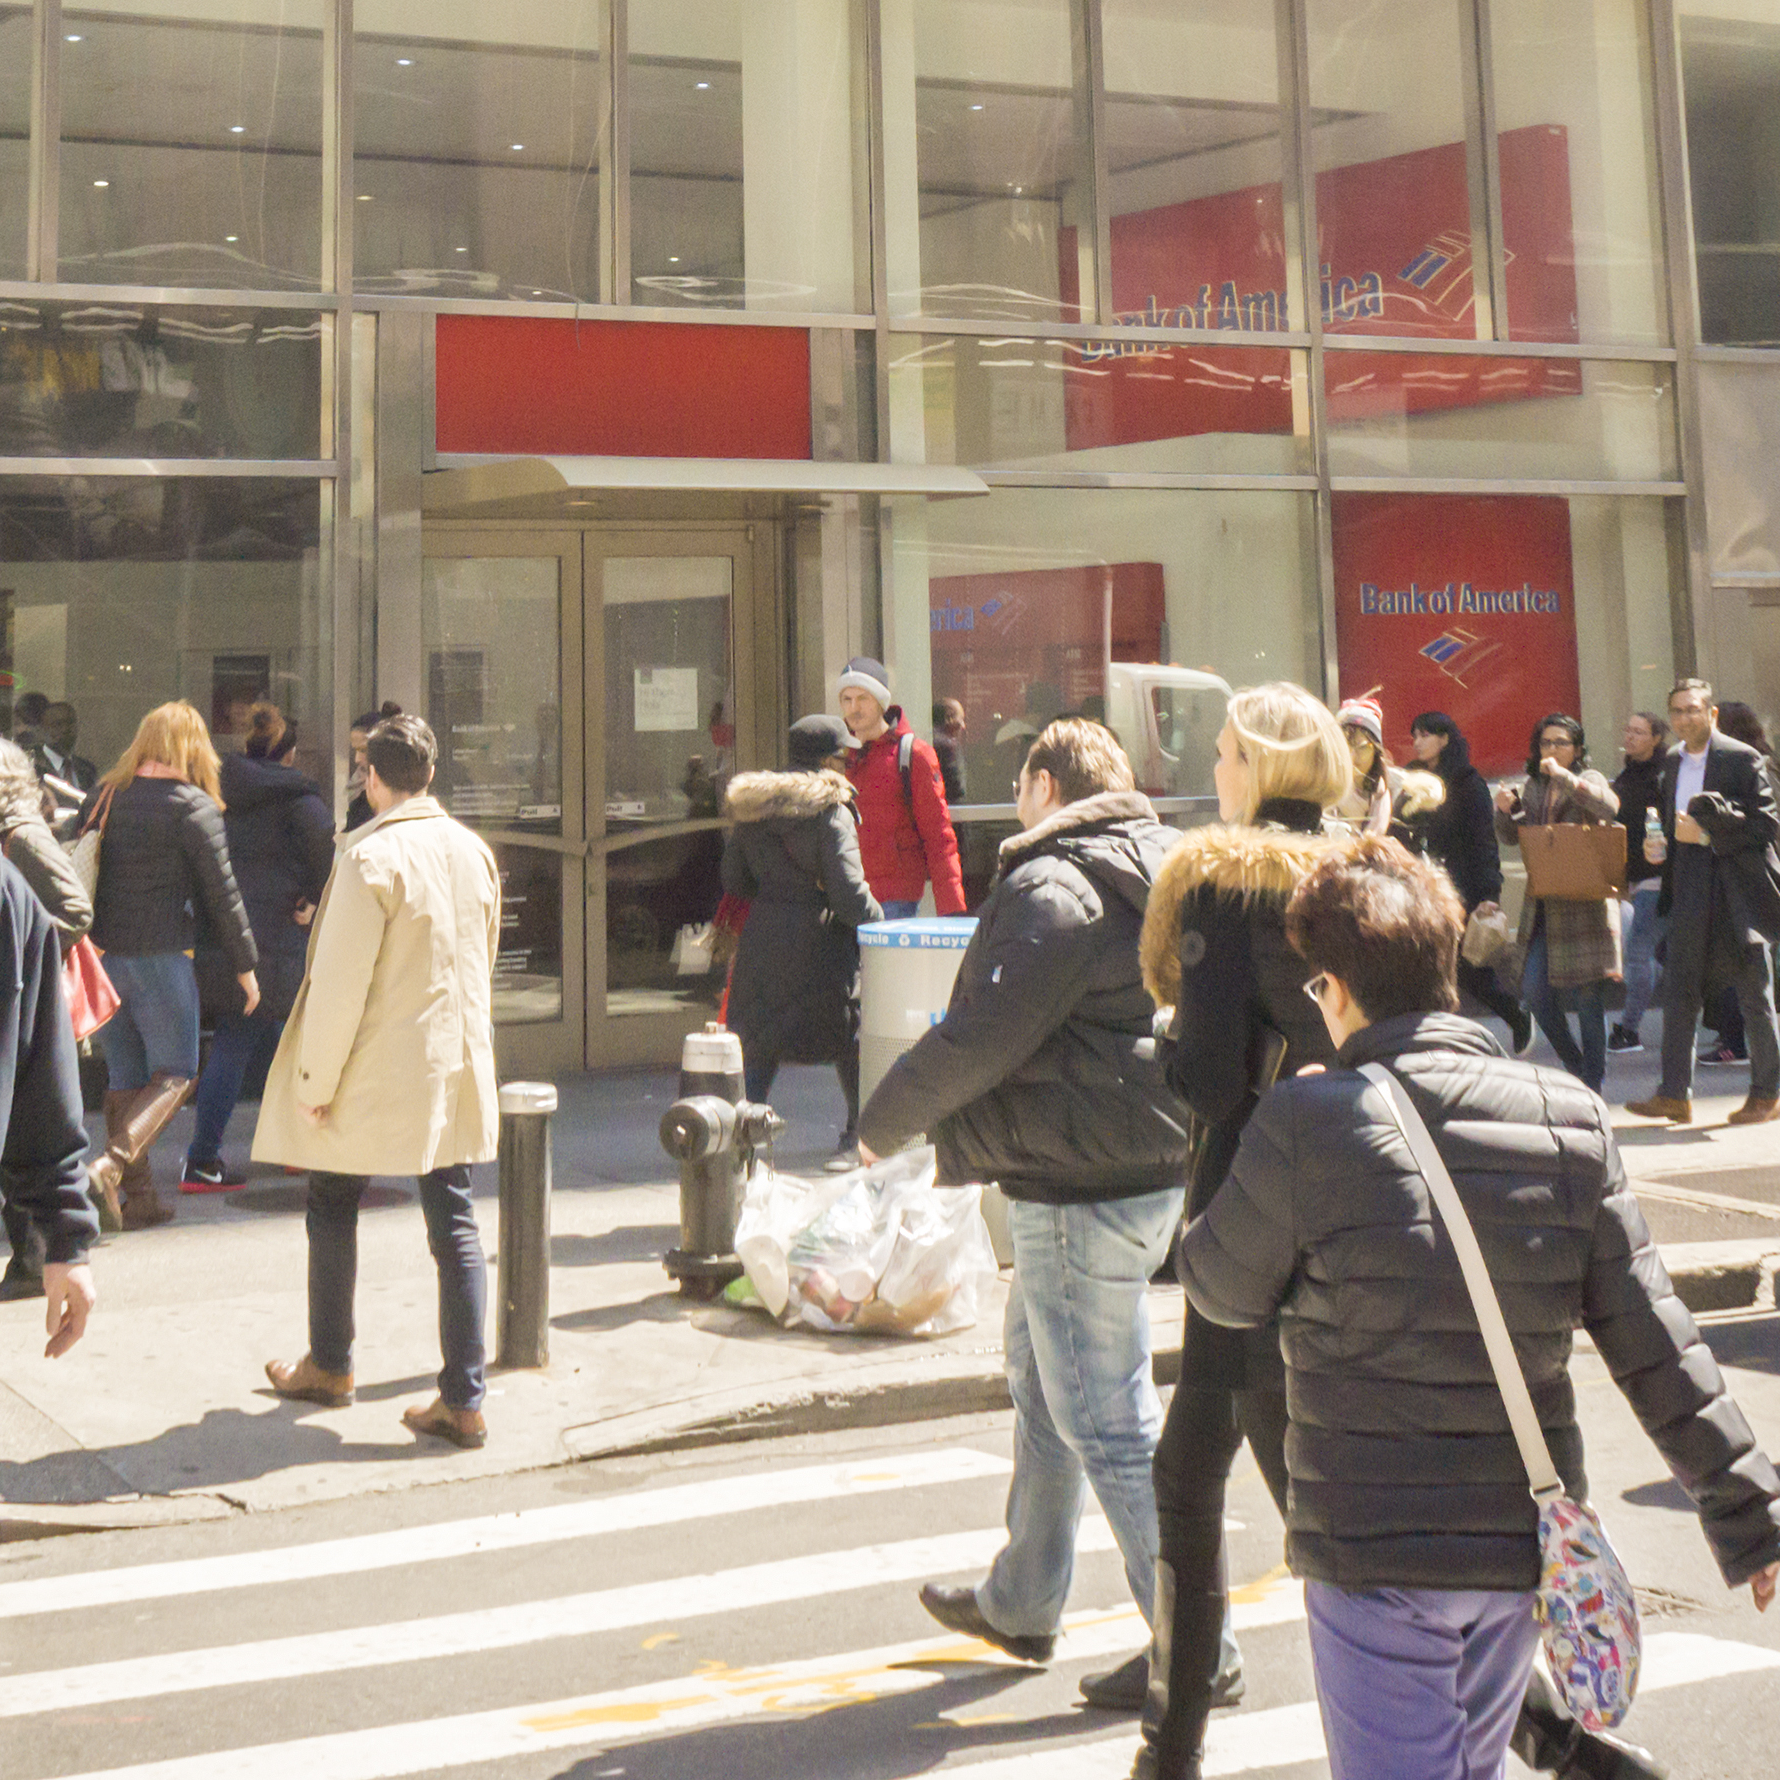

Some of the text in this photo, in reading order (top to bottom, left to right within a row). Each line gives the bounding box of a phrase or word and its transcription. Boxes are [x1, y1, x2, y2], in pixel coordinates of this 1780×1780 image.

[1359, 581, 1561, 615] Bank of America
[921, 934, 970, 948] Recyc
